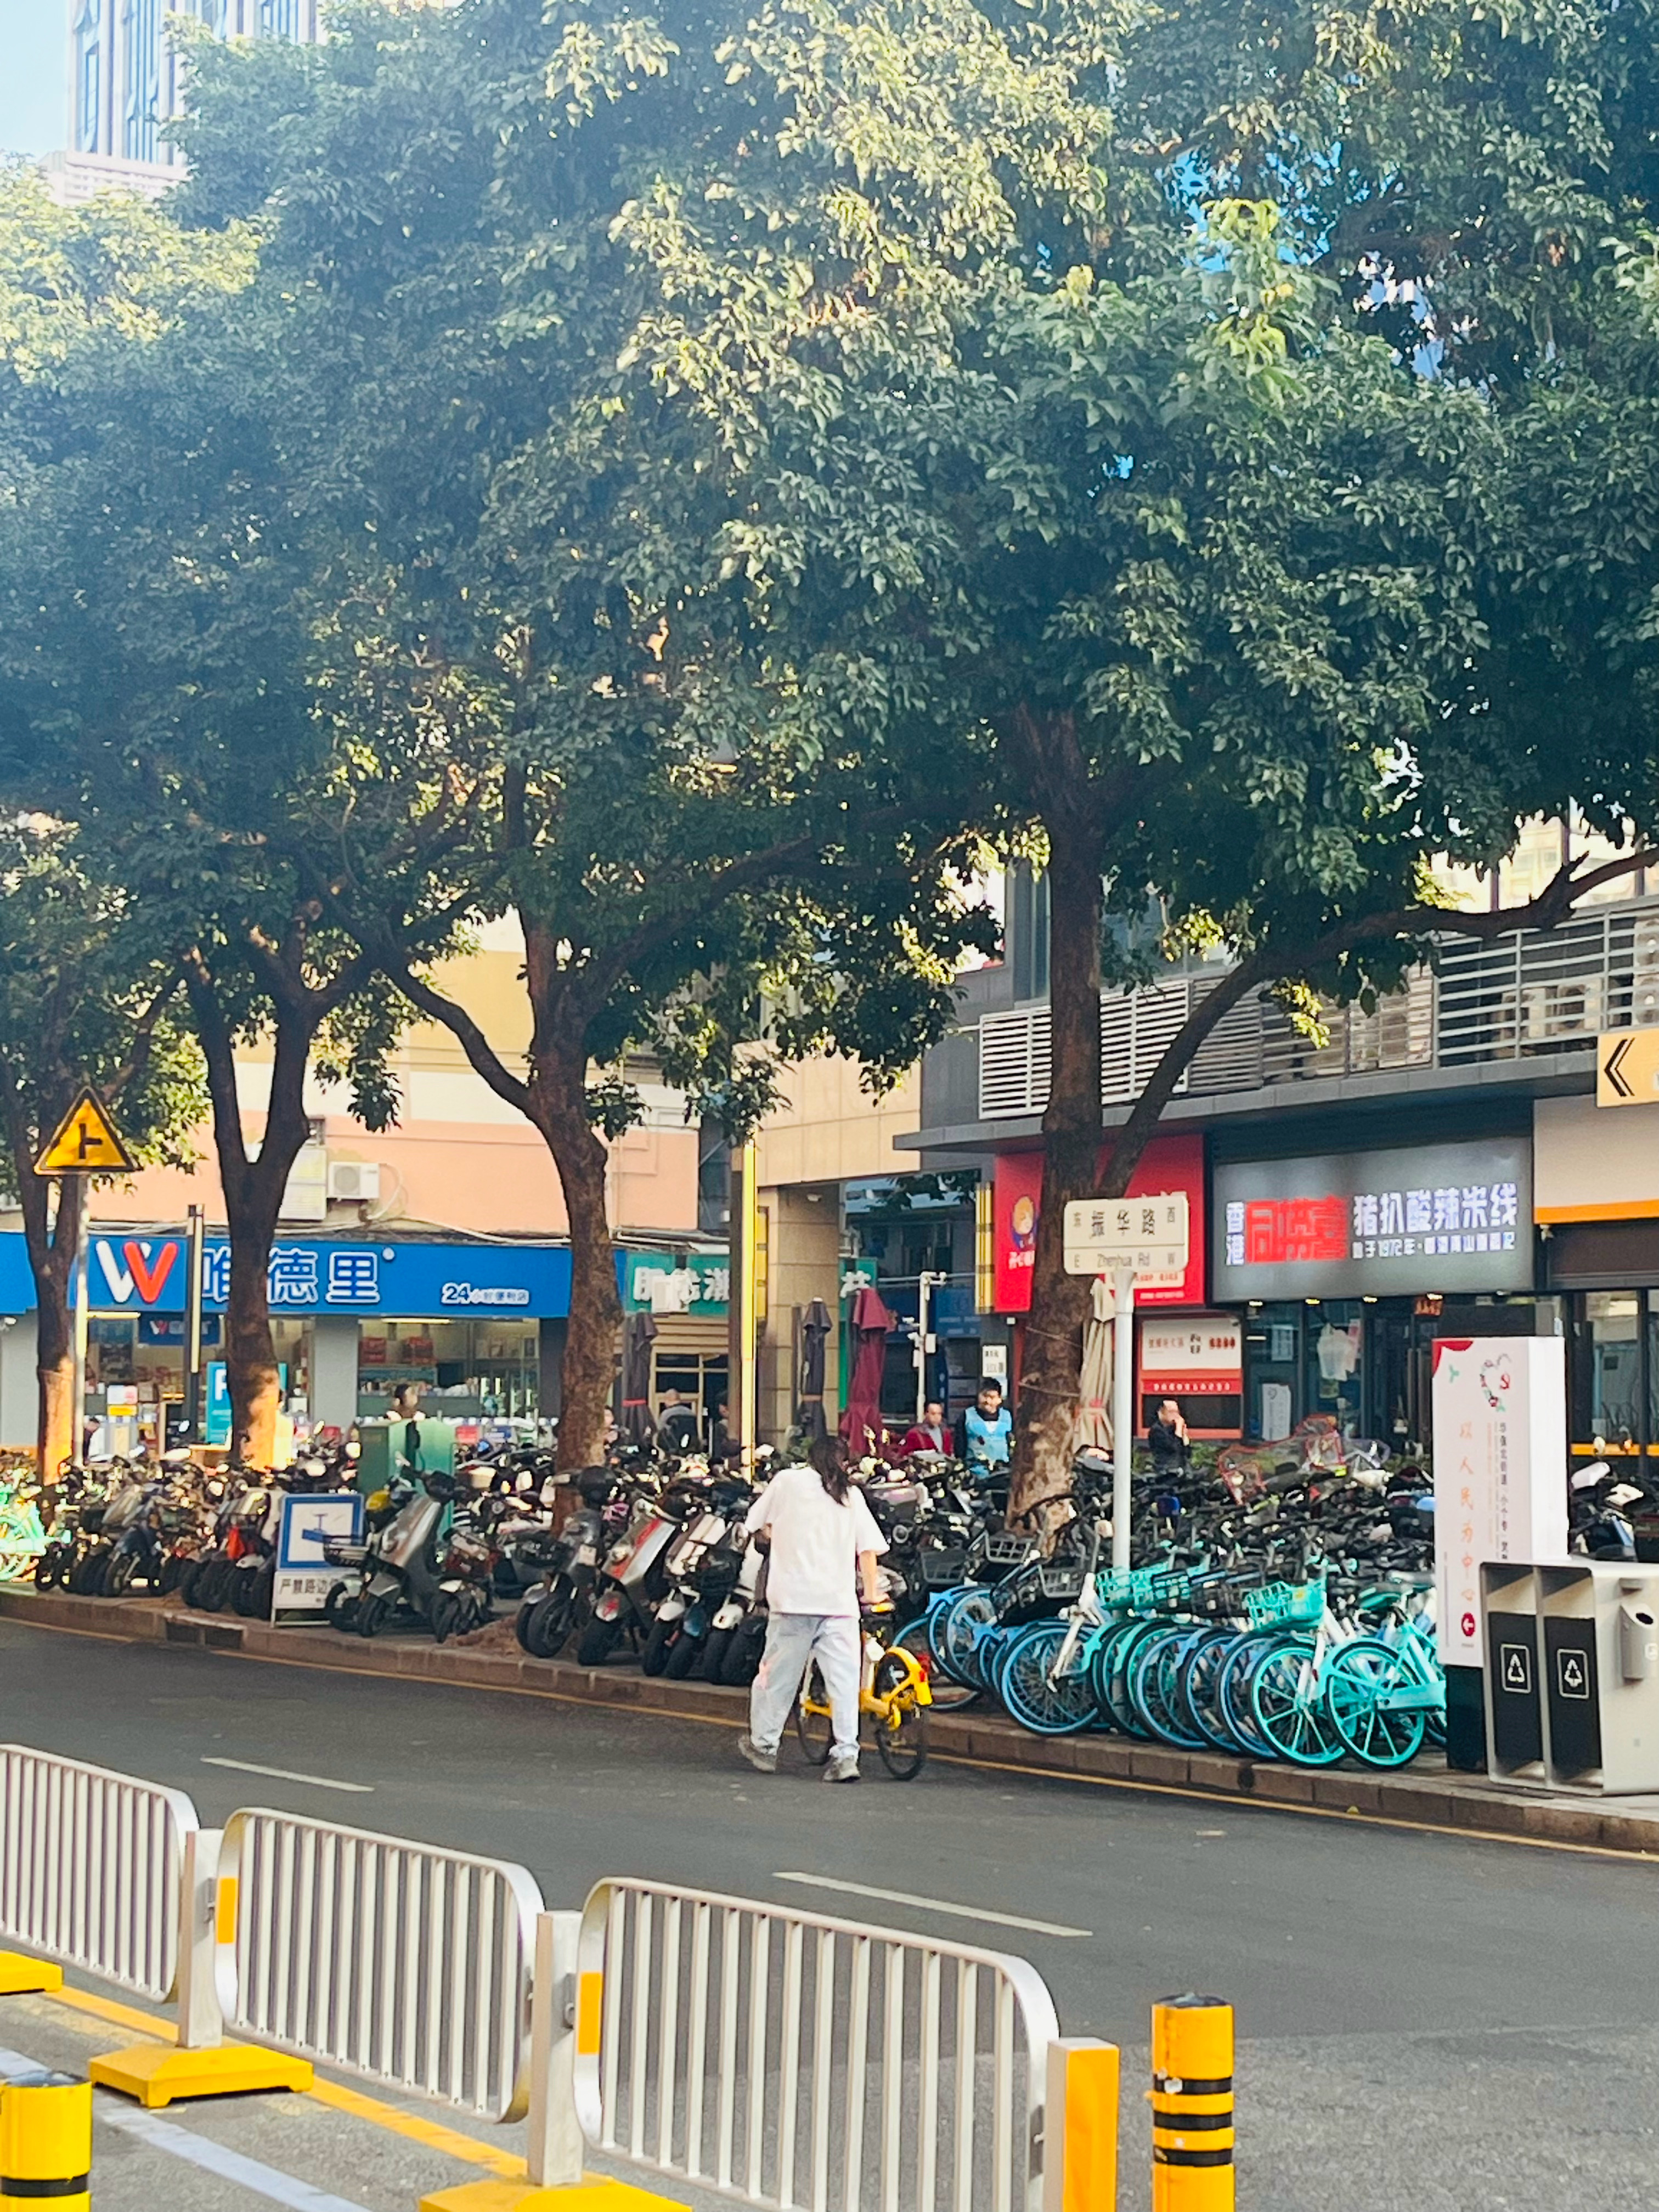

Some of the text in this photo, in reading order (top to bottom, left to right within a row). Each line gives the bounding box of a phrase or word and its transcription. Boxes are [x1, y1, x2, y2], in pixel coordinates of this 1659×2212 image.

[1353, 1183, 1517, 1237] 猪扒酸辣米线
[1074, 1254, 1081, 1268] E
